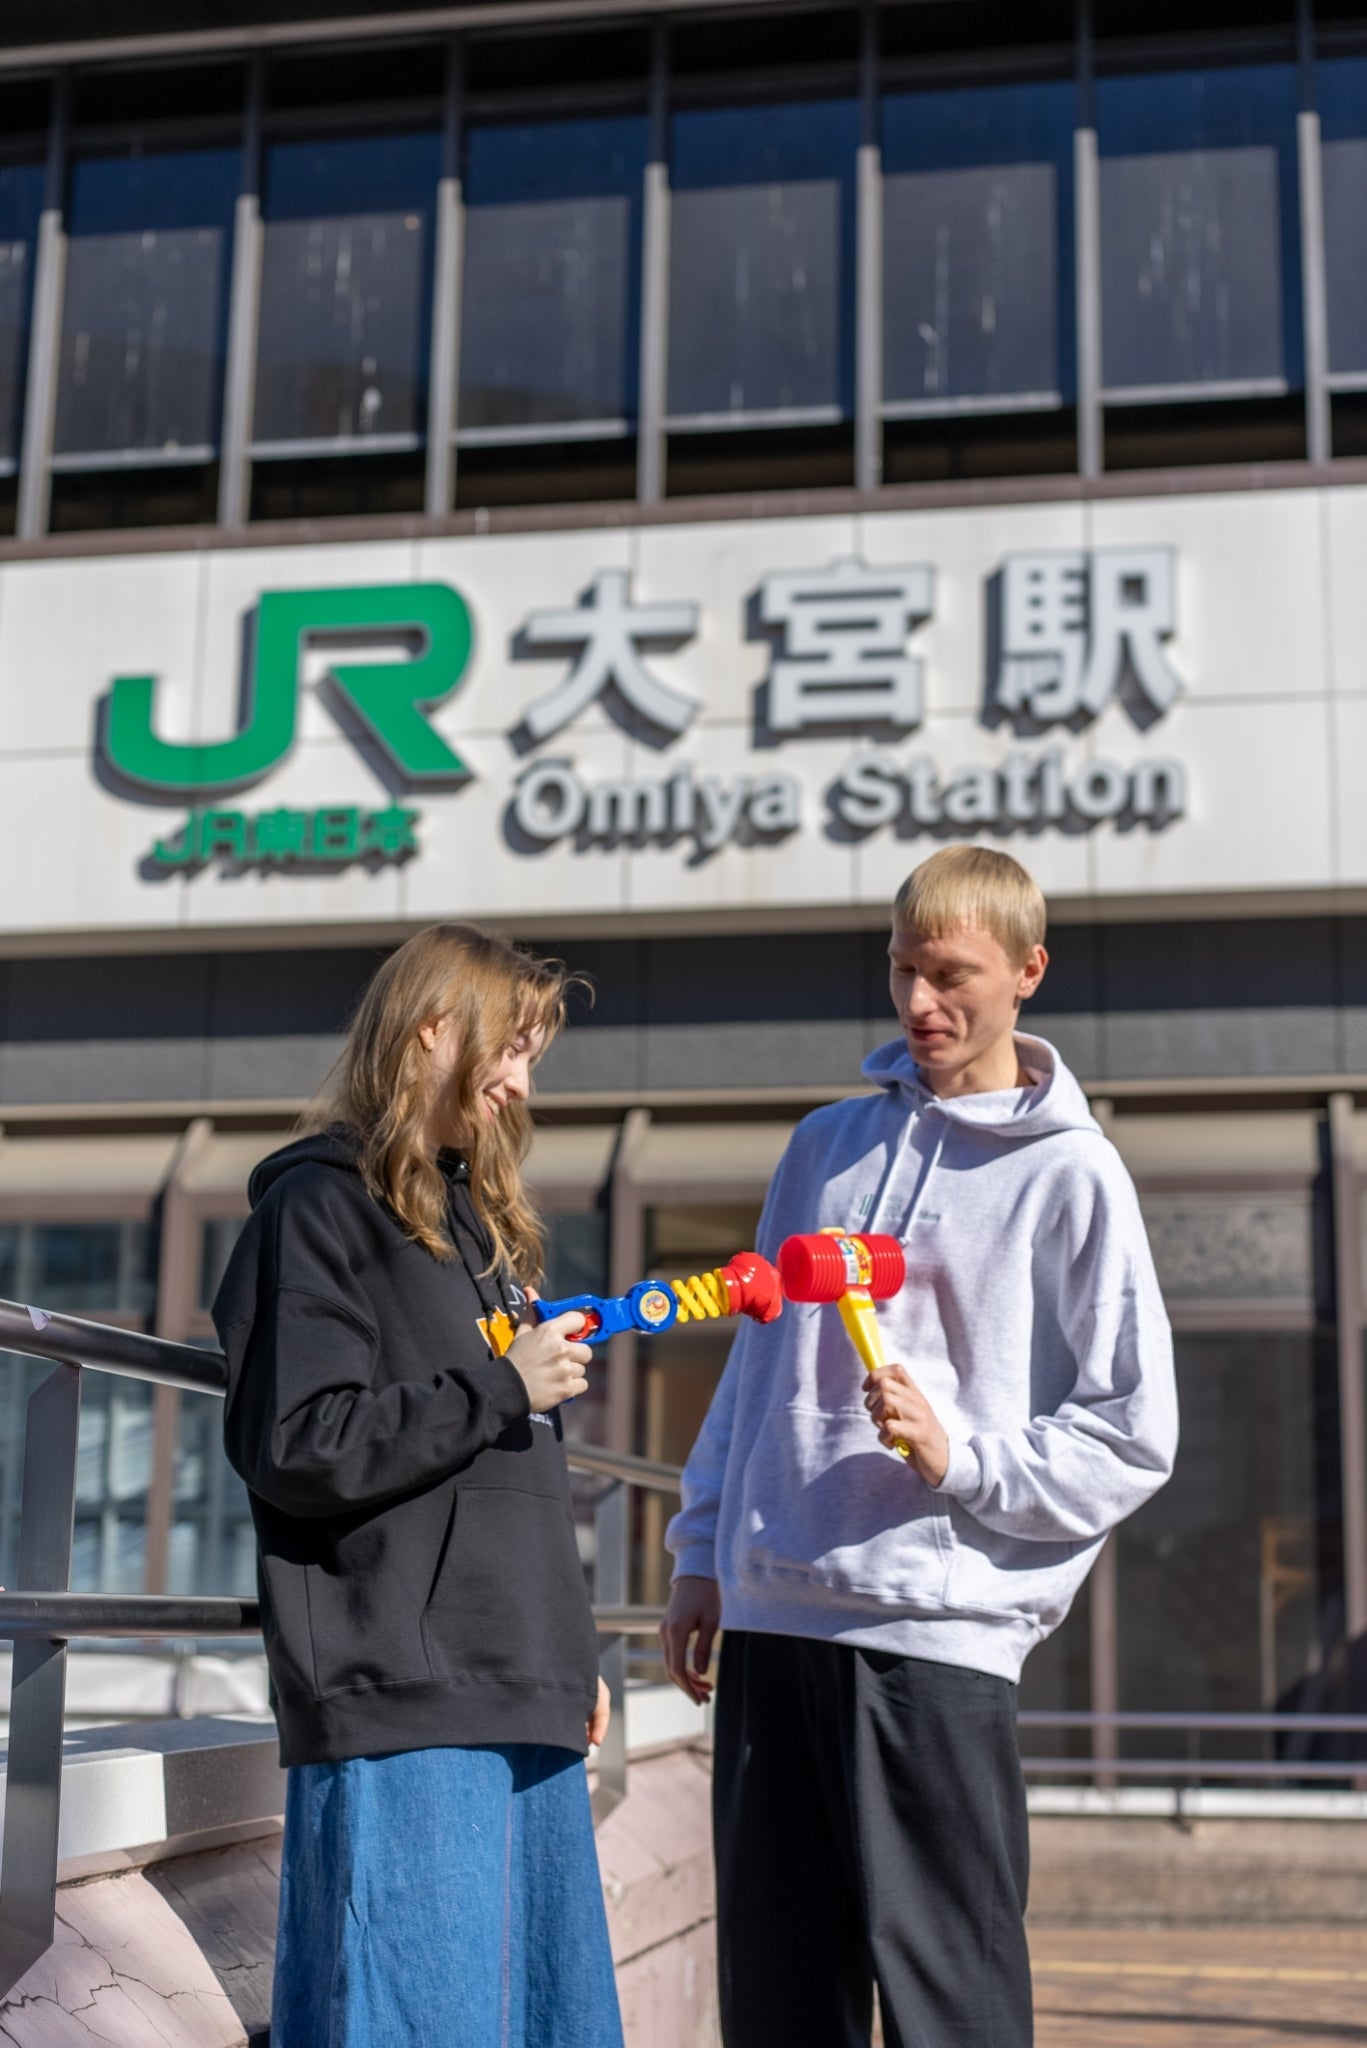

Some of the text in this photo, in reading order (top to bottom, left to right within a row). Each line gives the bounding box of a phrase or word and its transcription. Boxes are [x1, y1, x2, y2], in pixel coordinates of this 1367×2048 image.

[108, 581, 474, 789] JR
[525, 545, 1184, 738] 大宮駅
[837, 746, 1187, 828] Station
